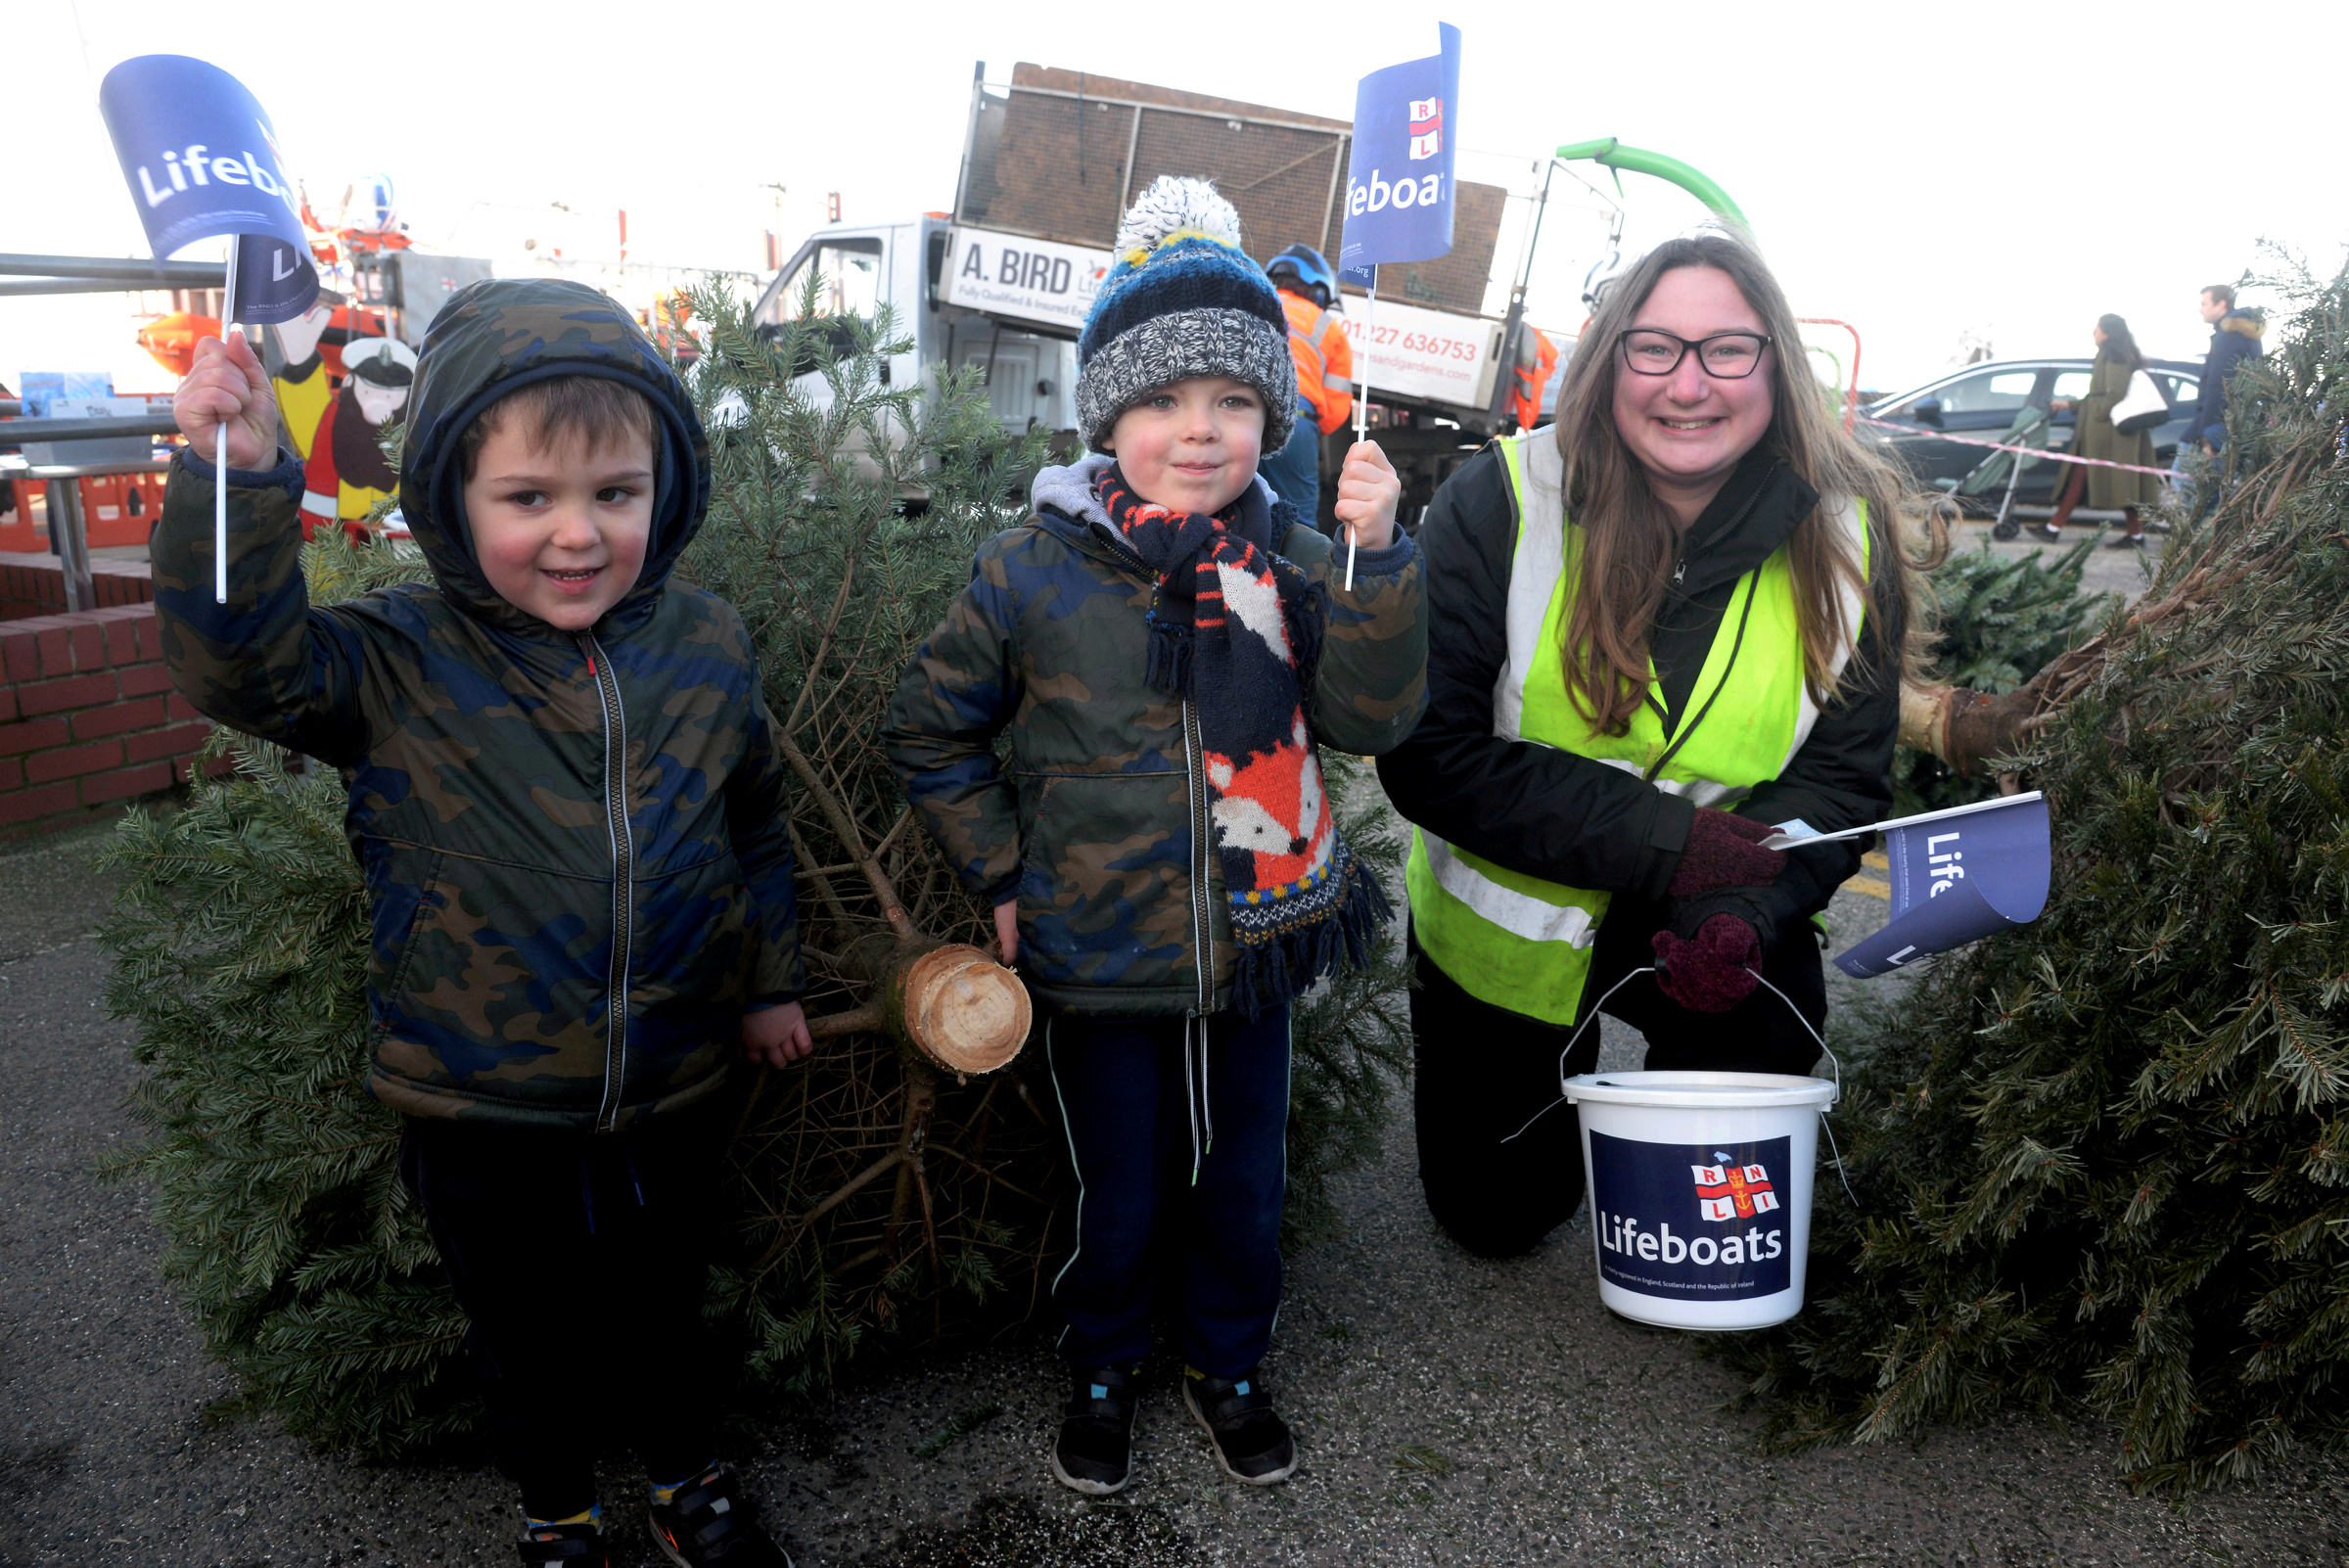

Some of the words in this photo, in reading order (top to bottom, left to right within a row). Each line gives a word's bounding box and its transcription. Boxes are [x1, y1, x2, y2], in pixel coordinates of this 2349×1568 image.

[962, 242, 990, 282] A.
[998, 249, 1073, 295] BIRD
[958, 284, 980, 300] Fully
[981, 288, 1024, 306] Qualified
[1025, 298, 1033, 308] &
[1035, 300, 1070, 314] Insured
[1403, 333, 1477, 362] 636753
[1702, 1169, 1718, 1183] R
[1749, 1166, 1763, 1180] N
[1600, 1210, 1782, 1266] Lifeboats
[1641, 1276, 1663, 1287] England,
[1662, 1280, 1685, 1289] Scotland
